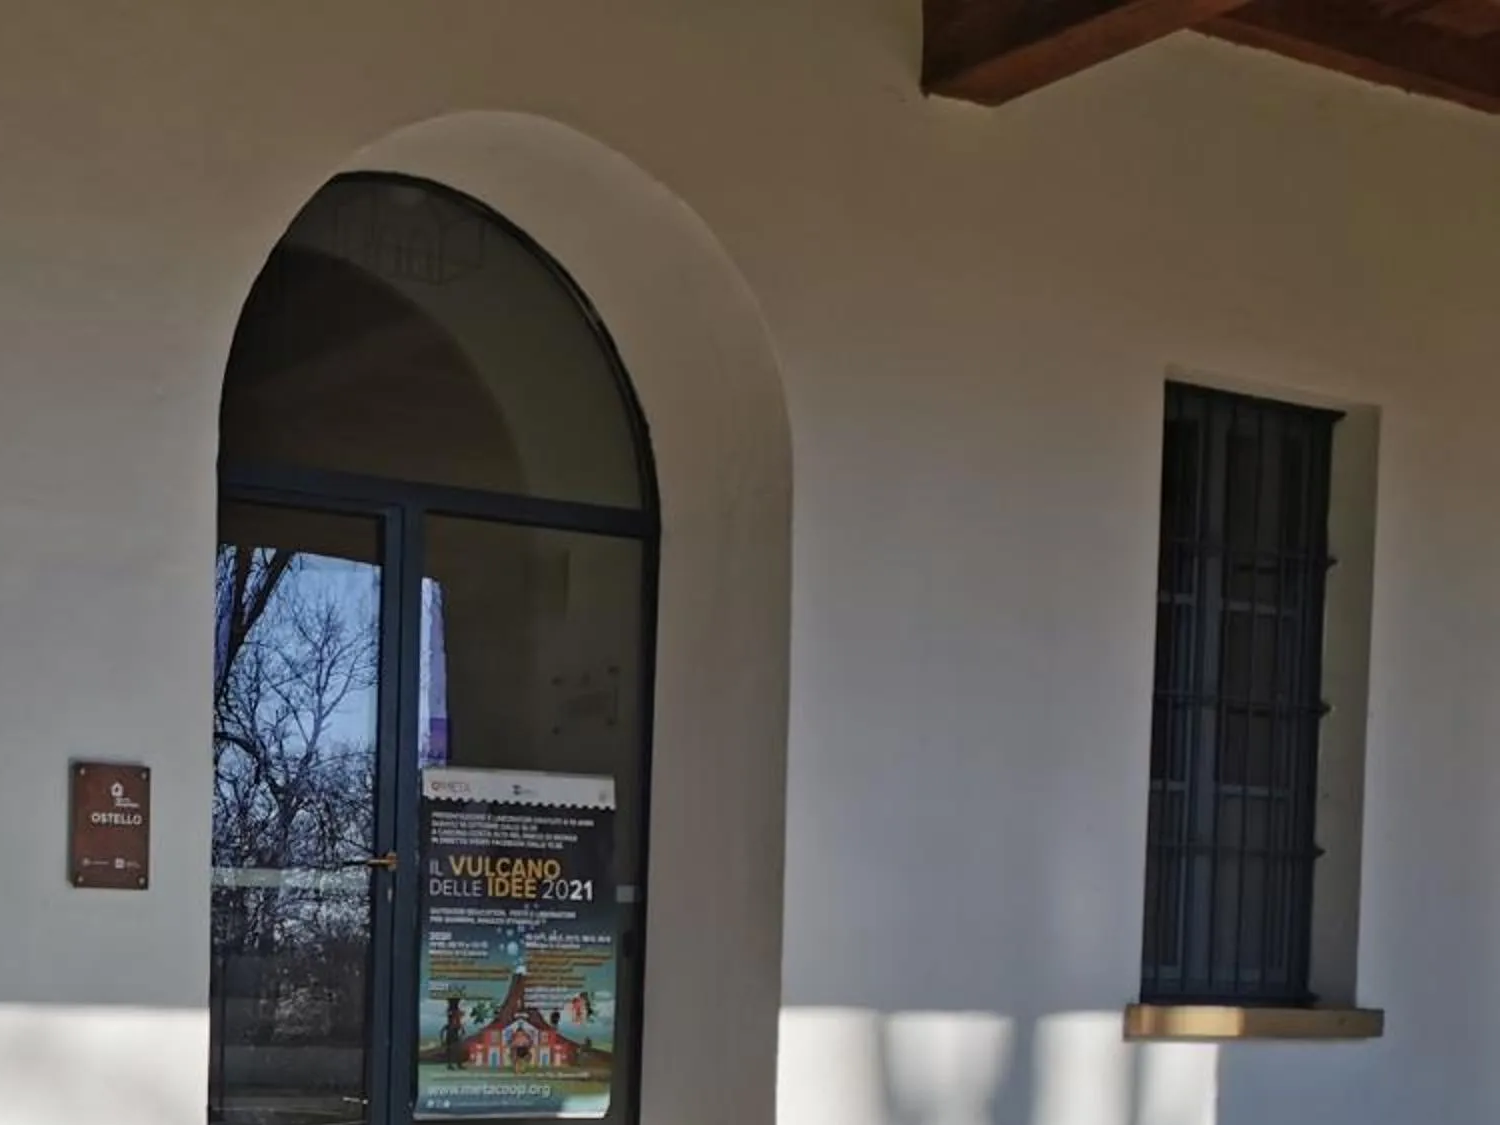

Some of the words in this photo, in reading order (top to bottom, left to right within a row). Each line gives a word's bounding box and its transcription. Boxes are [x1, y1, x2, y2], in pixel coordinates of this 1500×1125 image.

[91, 812, 142, 825] OSTELLO
[429, 859, 443, 876] IL
[449, 855, 561, 880] VULCANO
[429, 879, 482, 896] DELLE
[487, 877, 536, 898] IDEE
[542, 880, 593, 900] 2021
